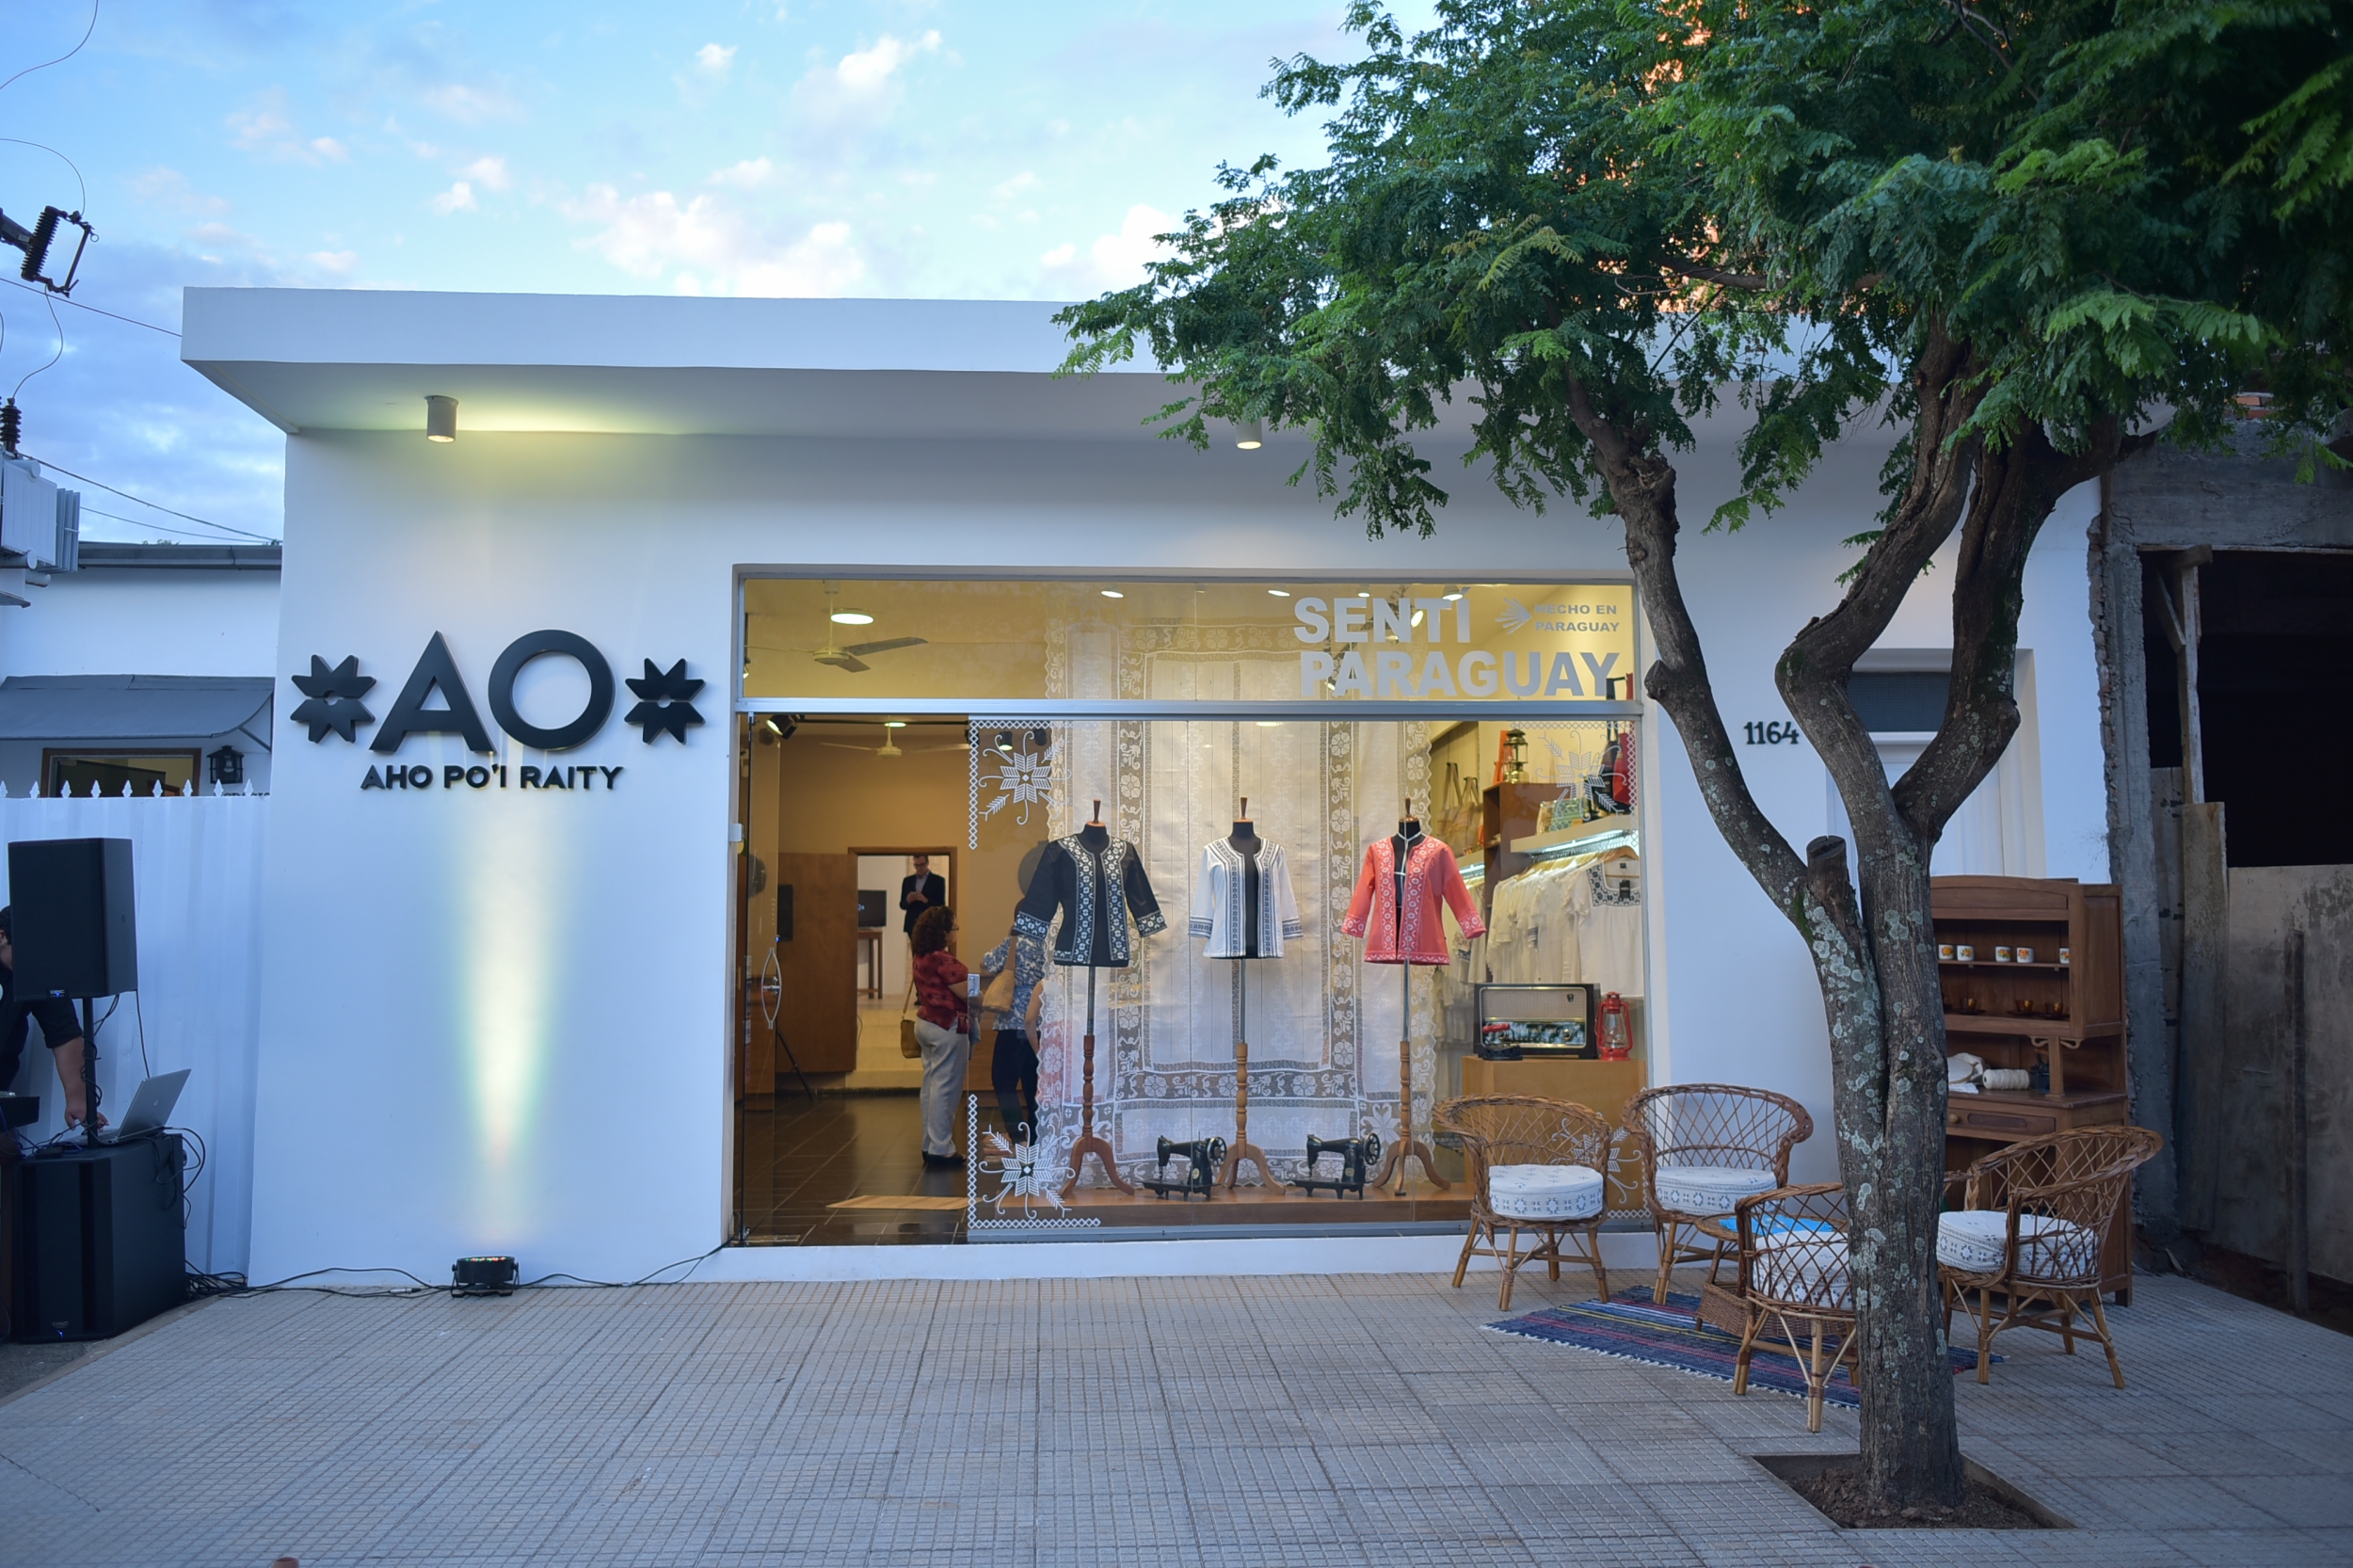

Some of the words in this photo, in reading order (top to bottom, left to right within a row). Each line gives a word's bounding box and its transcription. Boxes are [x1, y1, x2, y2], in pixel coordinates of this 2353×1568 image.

[1293, 586, 1471, 644] SENTÍ
[1534, 604, 1591, 615] HECHO
[1595, 604, 1617, 615] EN
[1534, 621, 1621, 632] PARAGUAY
[1300, 649, 1621, 697] PARAGUAY
[369, 628, 616, 754] AO
[1743, 720, 1800, 744] 1164
[360, 764, 433, 791] AHO
[520, 764, 624, 791] RAITY
